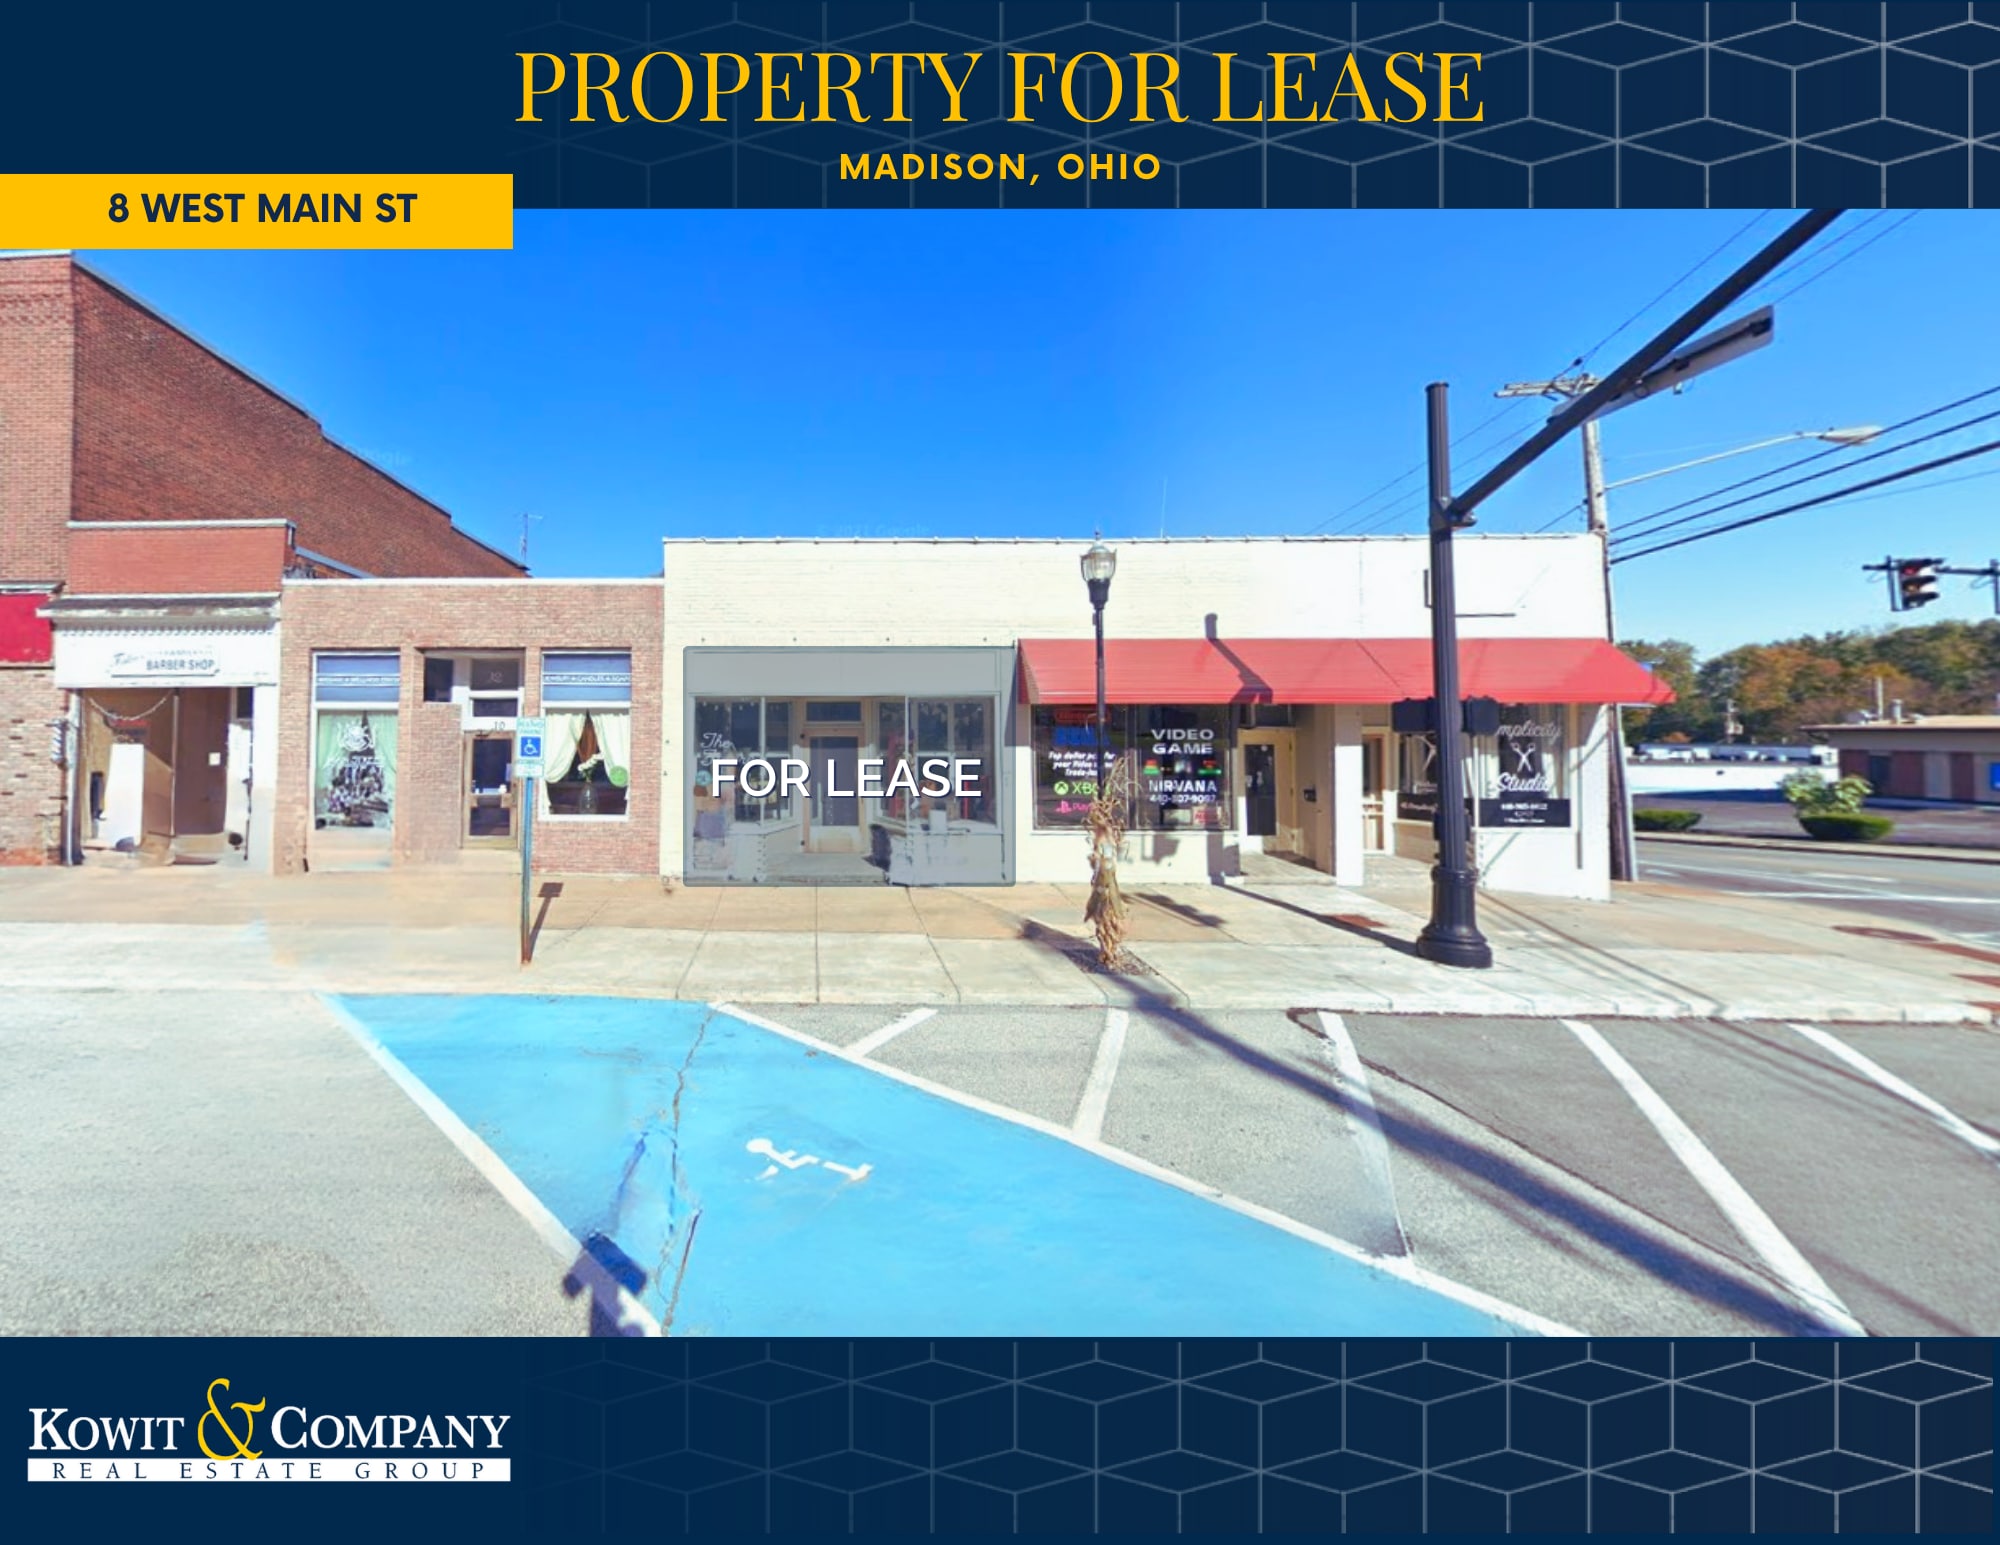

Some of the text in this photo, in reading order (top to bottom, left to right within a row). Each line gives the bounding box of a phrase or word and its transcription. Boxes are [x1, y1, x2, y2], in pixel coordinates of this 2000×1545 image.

[146, 659, 186, 671] BARBER
[188, 659, 215, 671] SHOP
[1151, 729, 1214, 741] VIDEO
[1494, 720, 1561, 745] mplicity
[701, 732, 732, 749] The
[1152, 743, 1213, 755] GAME
[1149, 780, 1217, 792] NIRVANA
[1497, 771, 1550, 792] Studio
